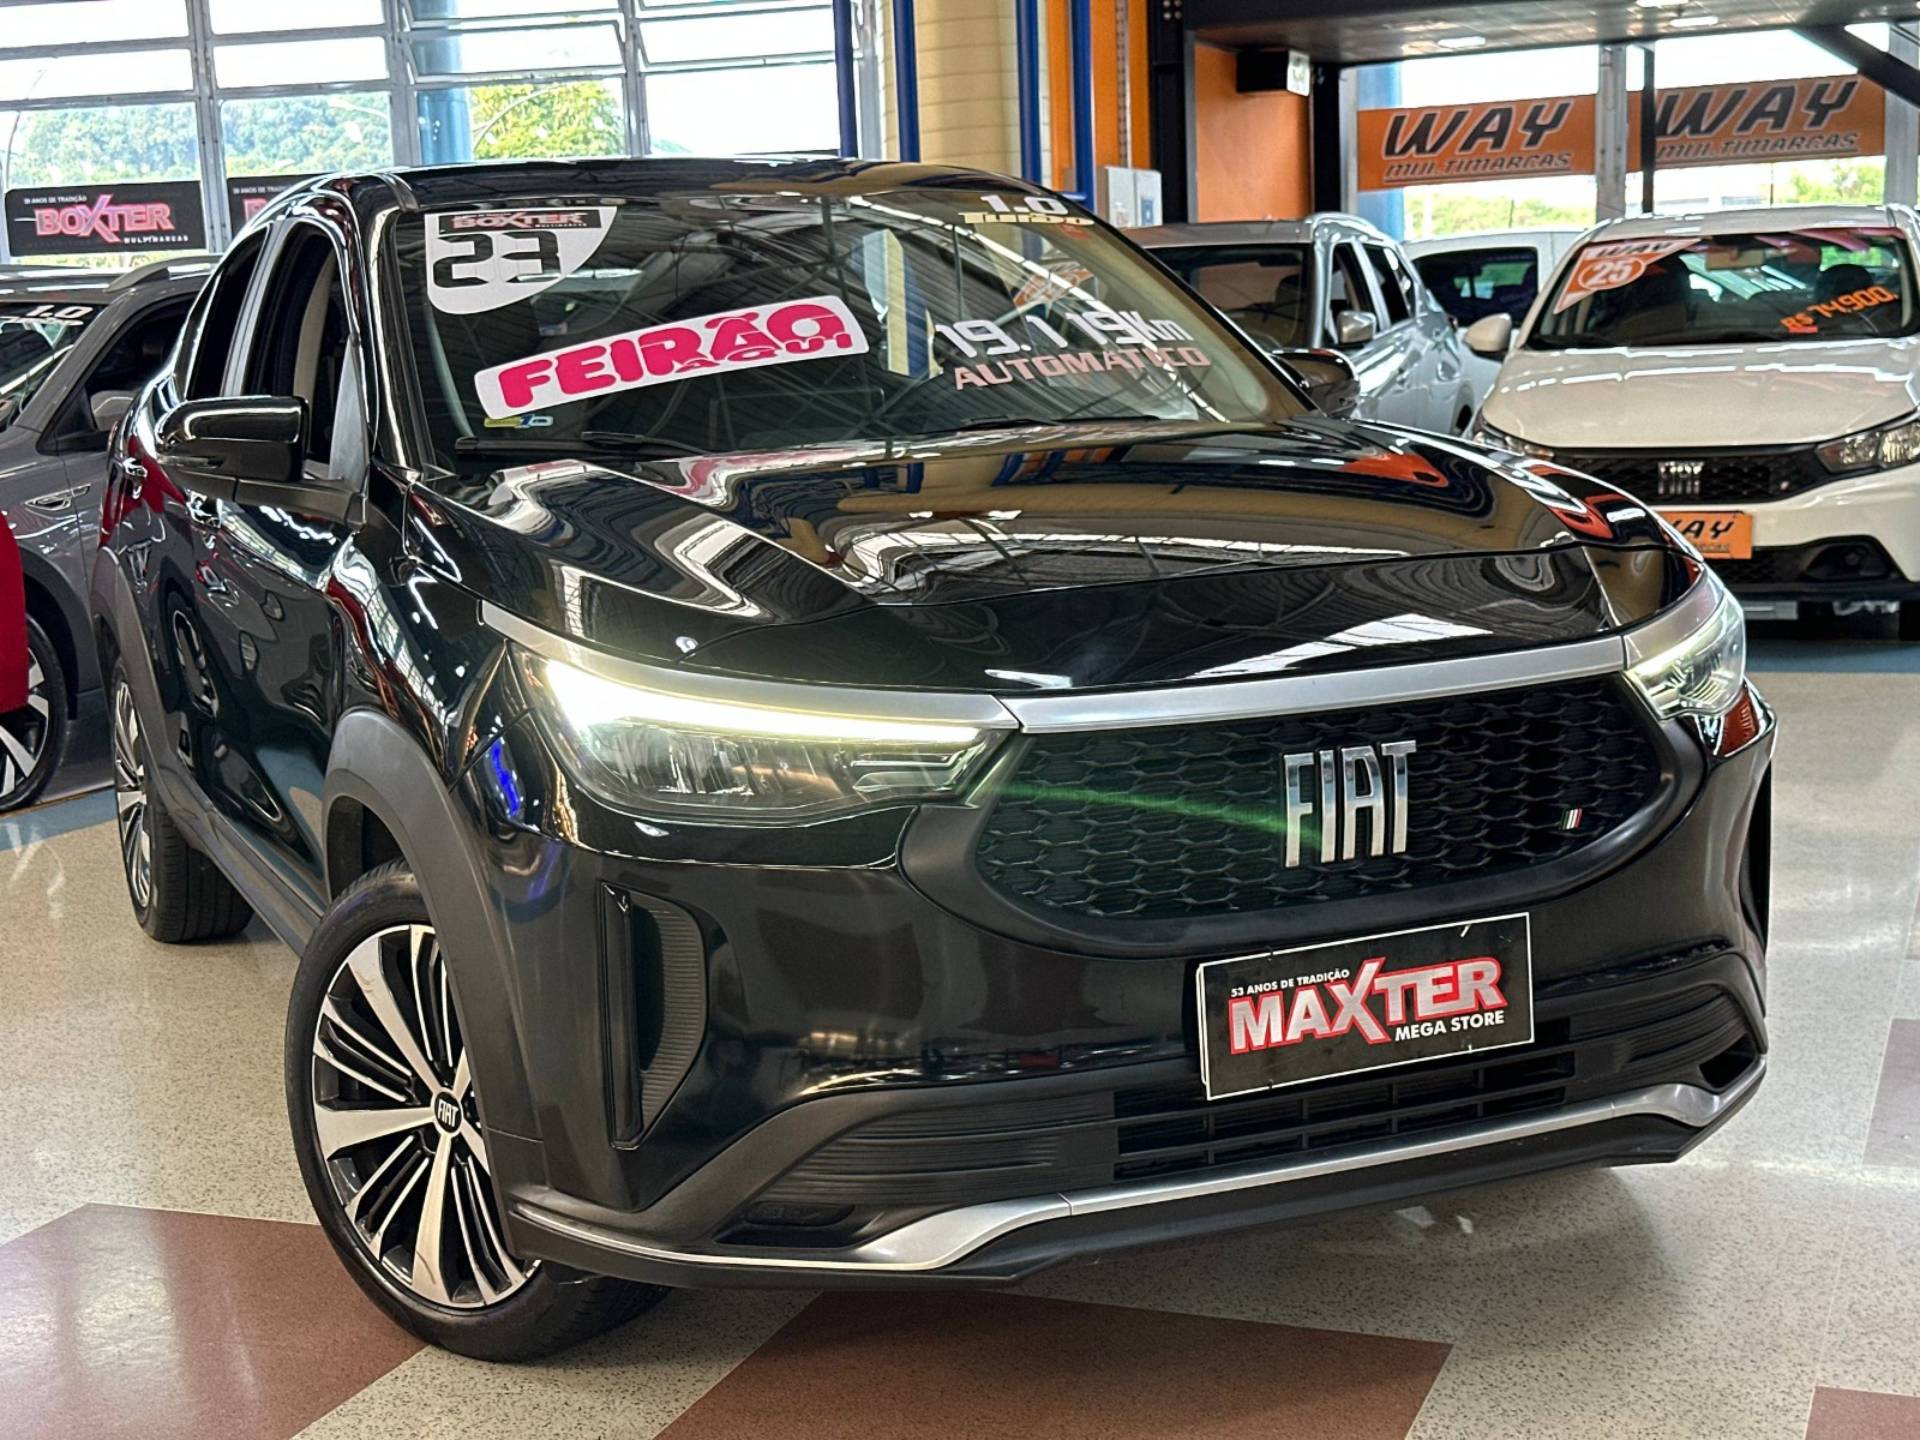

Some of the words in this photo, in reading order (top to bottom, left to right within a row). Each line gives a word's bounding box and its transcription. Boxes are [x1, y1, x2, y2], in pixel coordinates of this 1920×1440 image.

[1382, 98, 1573, 160] WAY
[33, 193, 175, 243] BOXTER
[451, 211, 588, 229] BOXTER
[980, 194, 1068, 215] 1.0
[432, 230, 562, 289] 23
[1583, 259, 1633, 287] 25
[25, 304, 94, 319] 1.0
[498, 304, 846, 408] FEIRÃO
[1672, 520, 1734, 539] AY
[1284, 739, 1417, 868] FIAT
[1231, 987, 1244, 998] 53
[1247, 981, 1278, 995] ANOS
[1280, 978, 1295, 989] DE
[1297, 968, 1350, 986] TRADIÇÃO
[1229, 956, 1508, 1054] MAXTER
[1395, 1020, 1447, 1042] MEGA
[1451, 1010, 1505, 1032] STORE
[437, 1099, 459, 1128] FIAT
